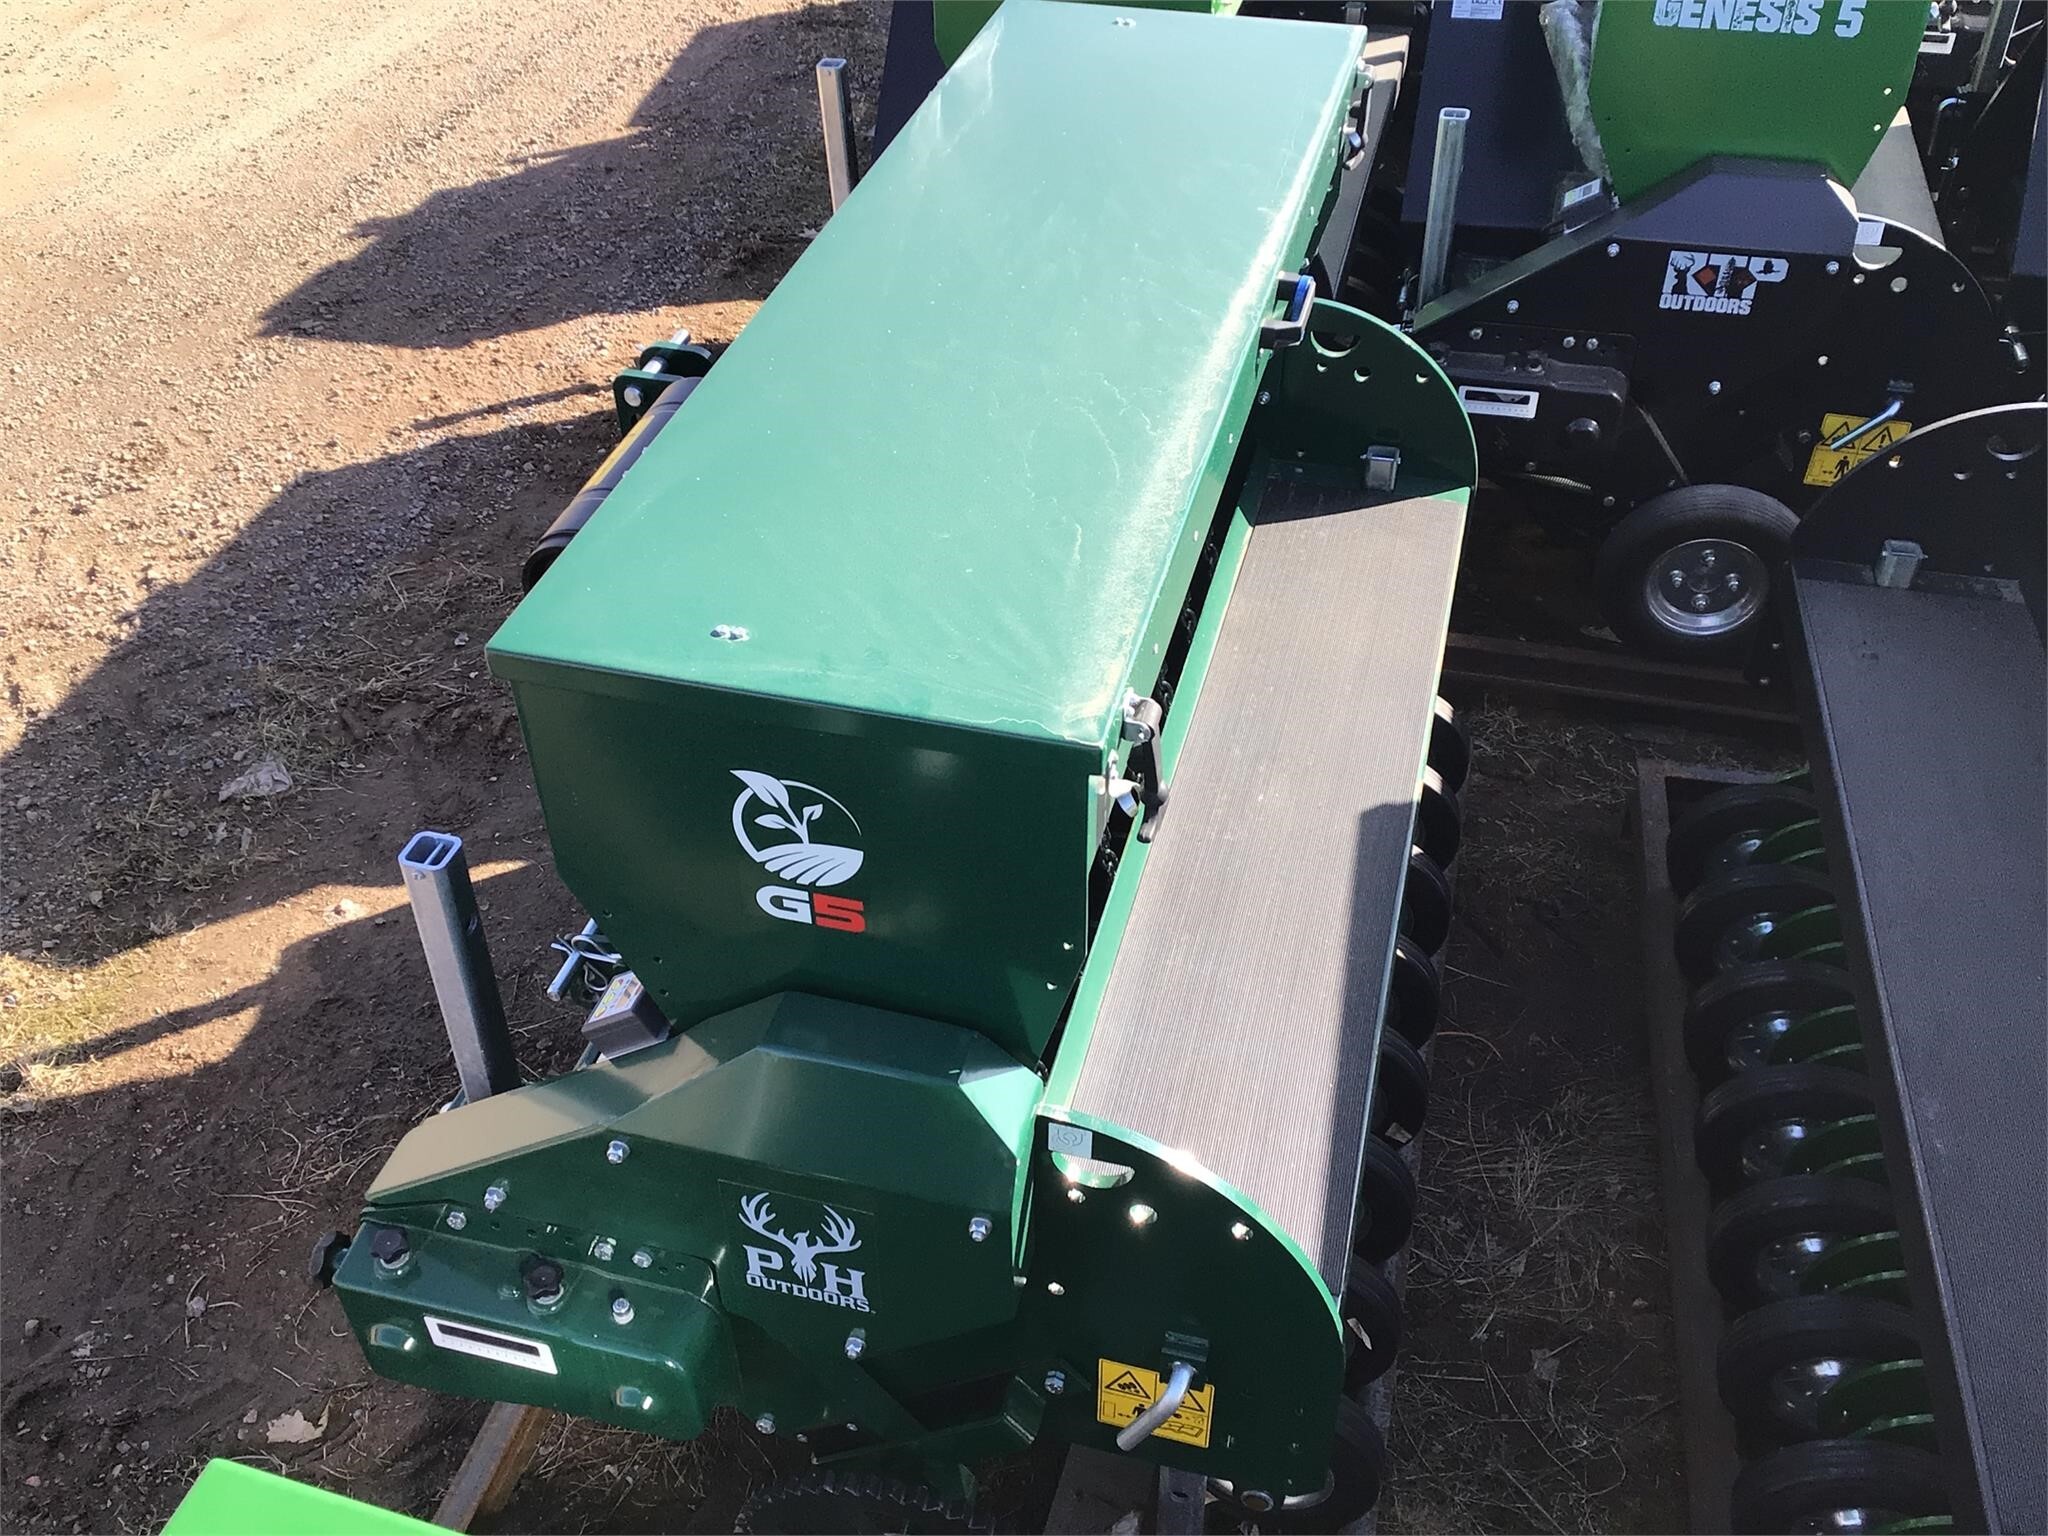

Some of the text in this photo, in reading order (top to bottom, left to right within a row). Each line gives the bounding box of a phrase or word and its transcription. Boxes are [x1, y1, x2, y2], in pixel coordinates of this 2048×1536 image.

[1653, 0, 1866, 38] GENESIS 5
[1662, 250, 1789, 299] RTP
[1659, 293, 1752, 315] OUTDOORS
[756, 885, 865, 933] G5
[746, 1273, 870, 1313] OUTDOORS
